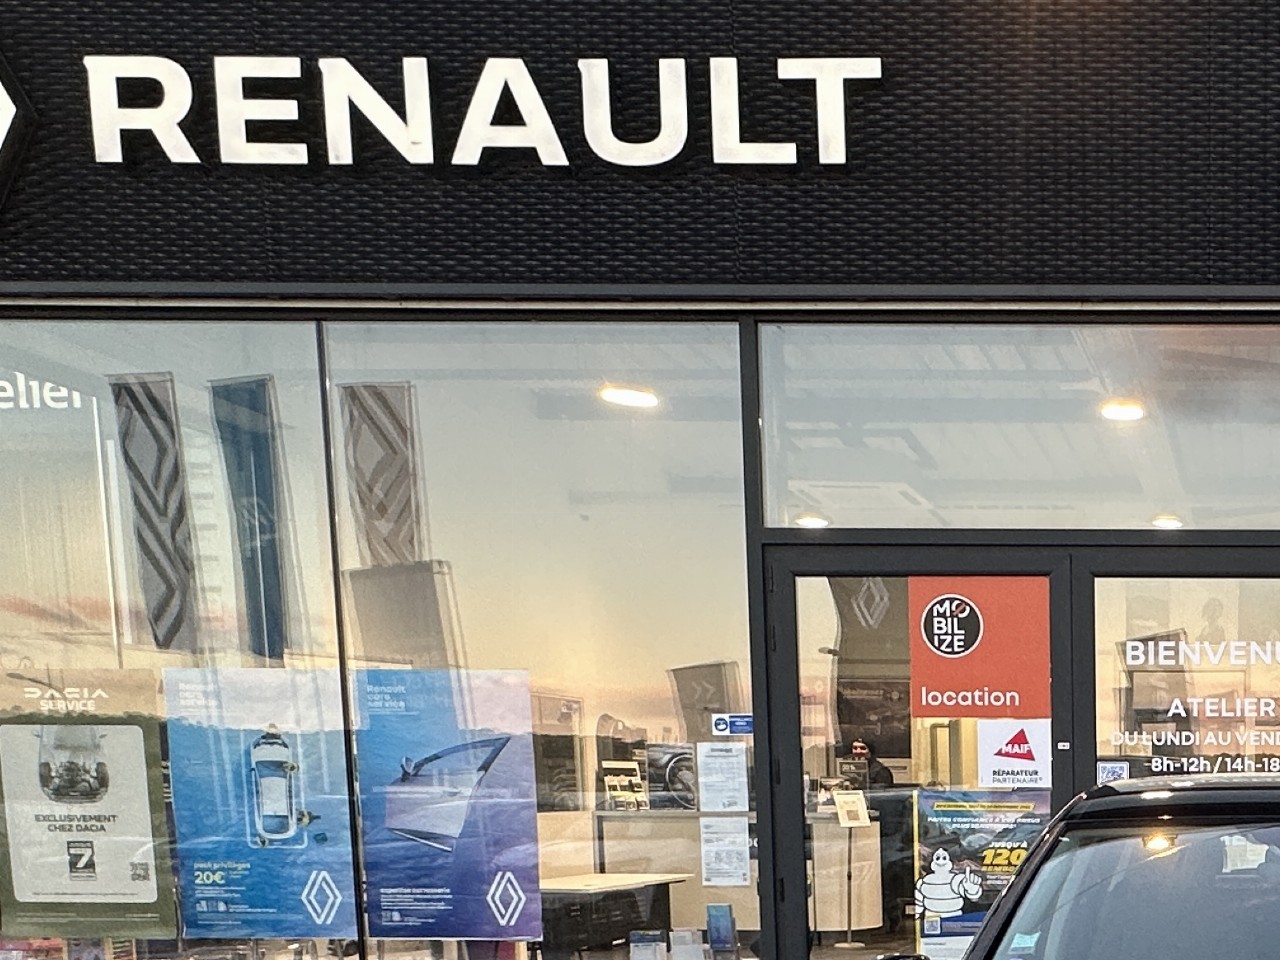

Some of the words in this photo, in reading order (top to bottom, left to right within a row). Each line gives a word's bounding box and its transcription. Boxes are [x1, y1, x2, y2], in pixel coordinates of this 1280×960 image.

[83, 54, 882, 166] RENAULT
[932, 617, 965, 635] BIL
[933, 635, 965, 652] IZE
[24, 688, 109, 698] DACIA
[921, 687, 1020, 706] location
[40, 700, 96, 711] SERVICE
[1167, 698, 1276, 717] ATELIER
[1112, 731, 1138, 746] DU
[1142, 731, 1199, 746] LUNDI
[1204, 731, 1231, 746] AU
[1002, 743, 1031, 753] MAIF
[34, 814, 117, 823] EXCLUSIVEMENT
[48, 824, 73, 832] CHEZ
[76, 824, 106, 832] DACIA
[69, 848, 93, 868] 7
[194, 871, 225, 884] 20€
